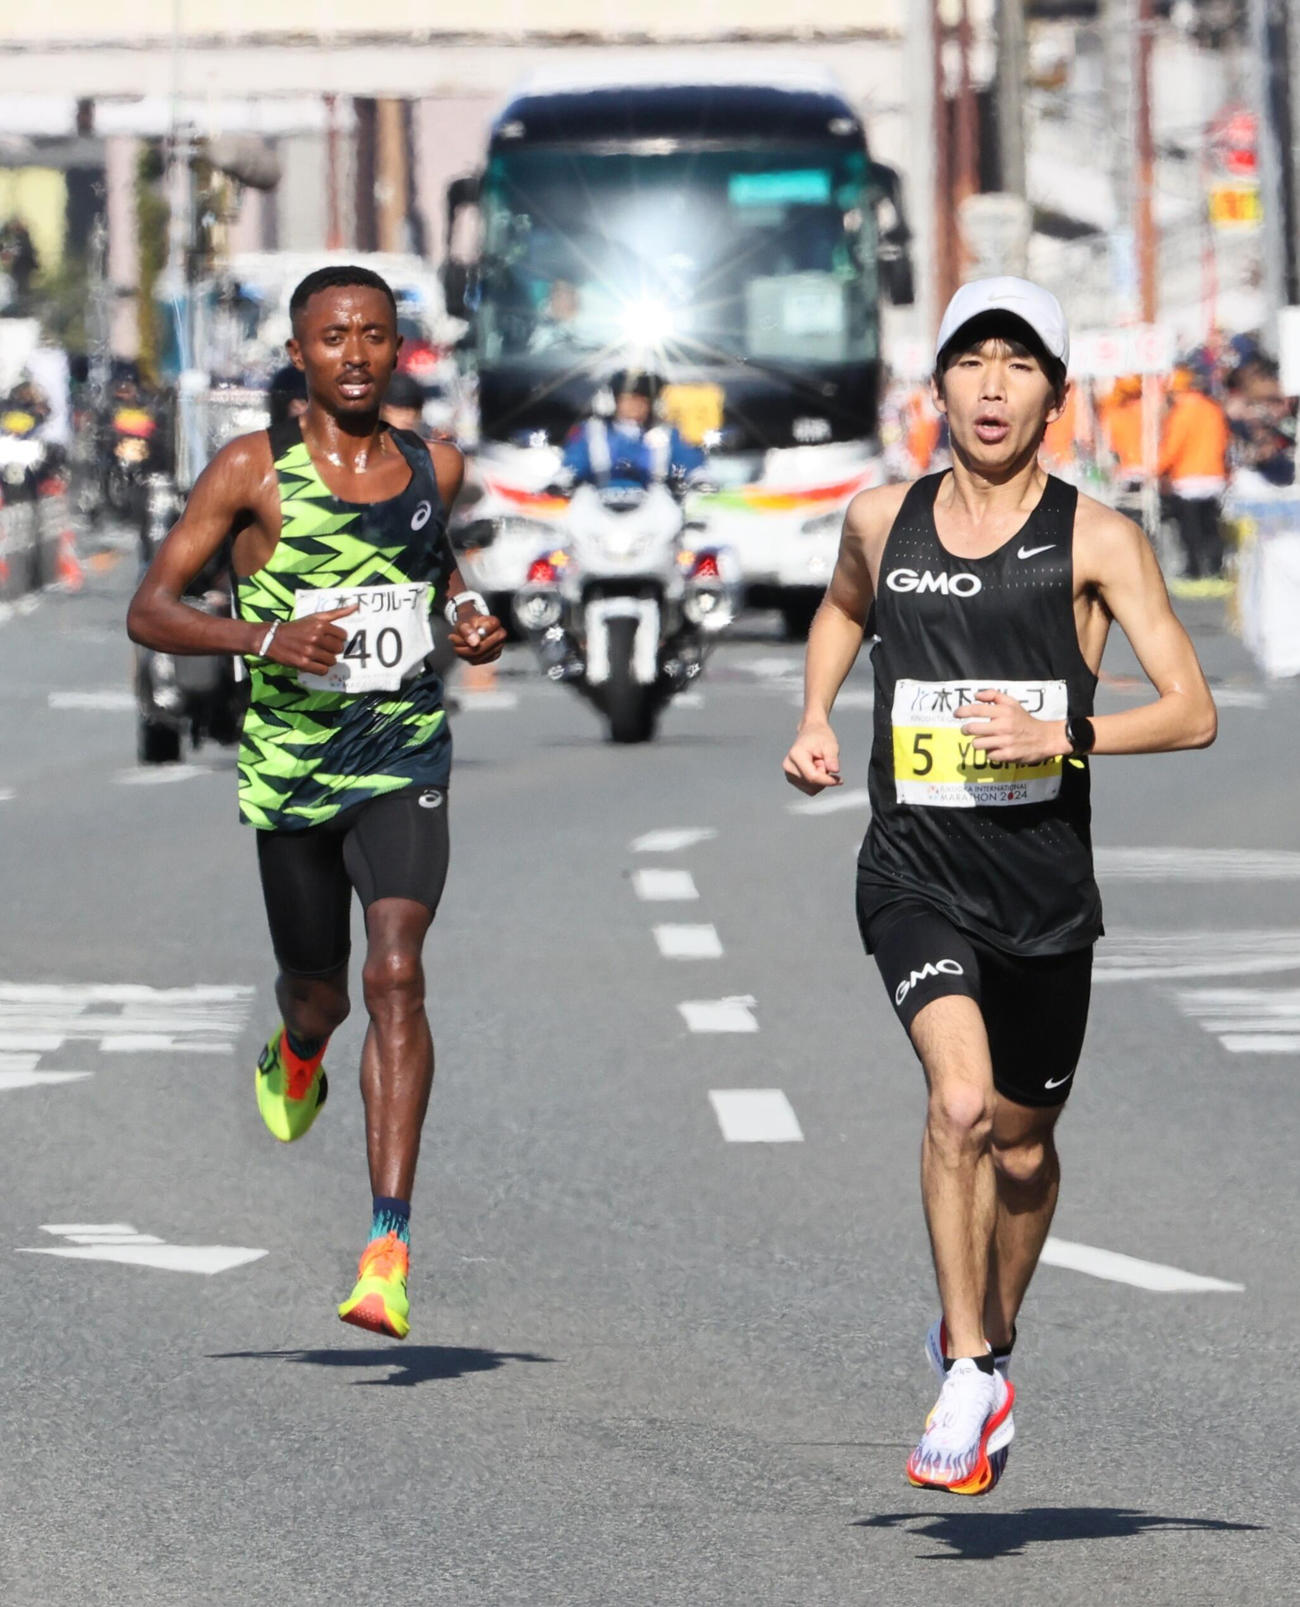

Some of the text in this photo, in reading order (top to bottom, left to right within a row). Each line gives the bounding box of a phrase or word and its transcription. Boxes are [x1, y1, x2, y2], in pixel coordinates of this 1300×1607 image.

[886, 568, 982, 597] GMO
[343, 627, 403, 669] 40
[931, 687, 1047, 713] 木下ープ
[912, 733, 933, 776] 5
[895, 958, 964, 1006] GMO
